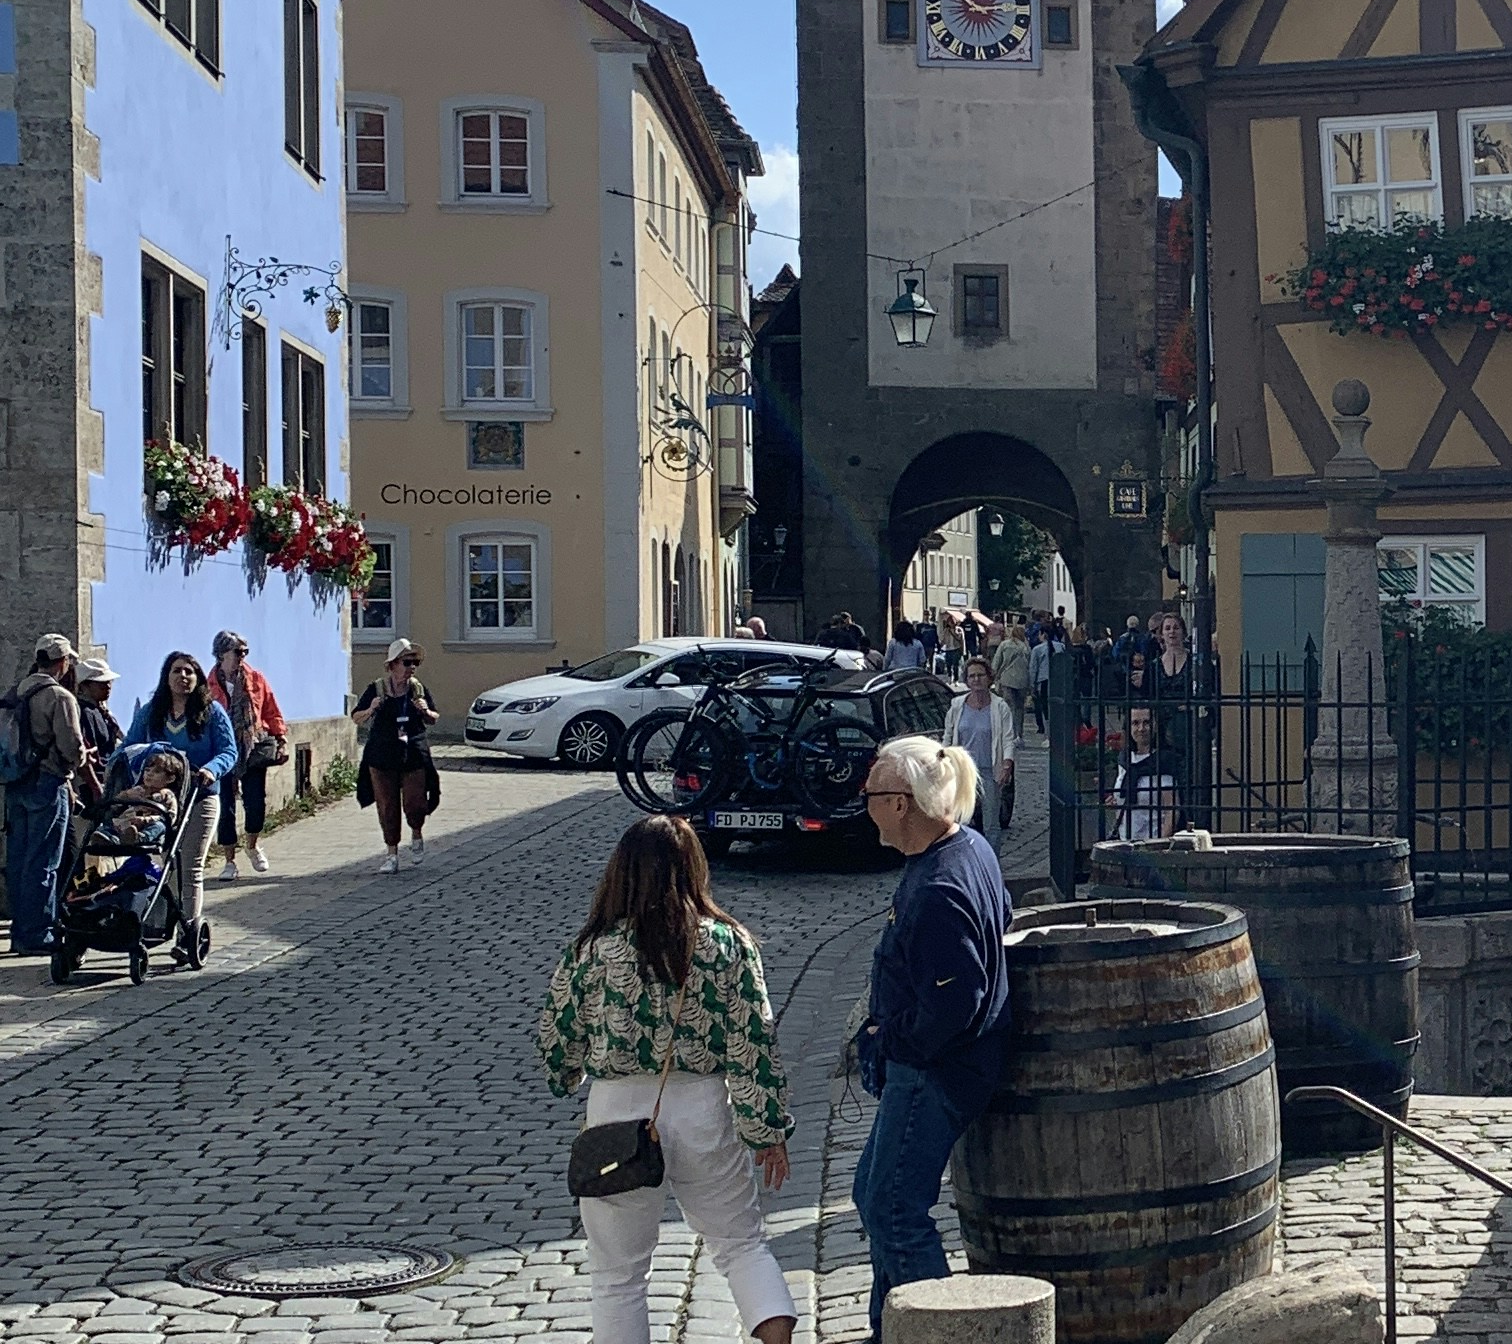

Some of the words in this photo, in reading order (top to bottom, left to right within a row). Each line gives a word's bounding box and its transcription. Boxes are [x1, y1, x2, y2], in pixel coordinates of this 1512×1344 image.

[926, 1, 941, 14] IX
[1016, 4, 1030, 16] III
[931, 20, 948, 41] VIII
[948, 38, 964, 56] VII
[974, 46, 987, 60] VI
[998, 41, 1009, 55] V
[381, 483, 552, 505] Chocolaterie
[716, 814, 732, 826] FD
[758, 814, 782, 827] 755
